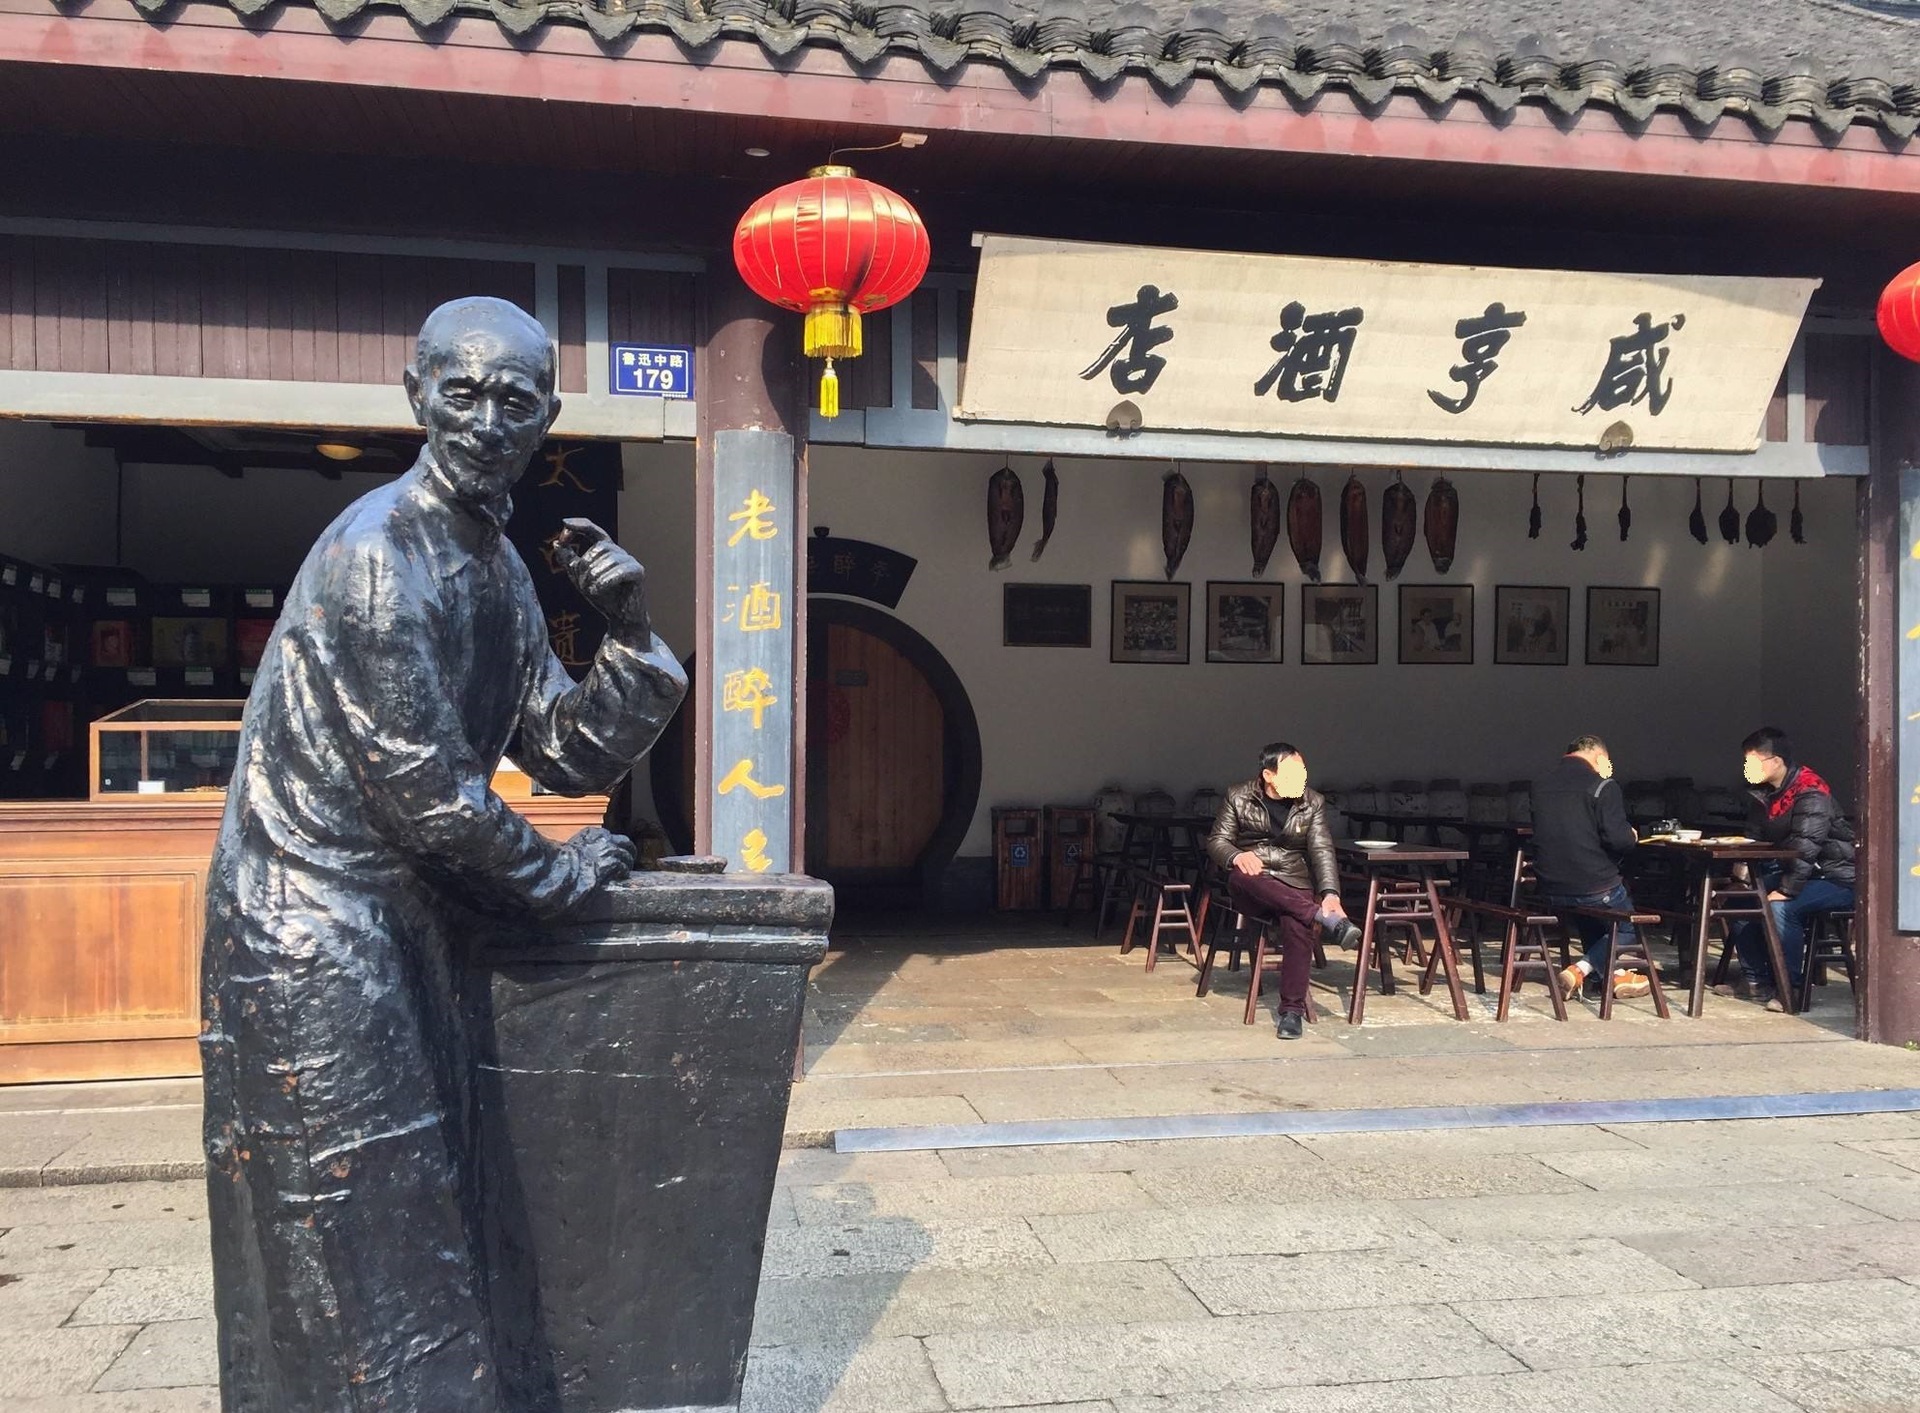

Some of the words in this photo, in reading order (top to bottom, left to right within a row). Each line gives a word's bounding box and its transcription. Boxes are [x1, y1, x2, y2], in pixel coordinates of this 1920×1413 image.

[622, 352, 684, 368] 鲁迅中路
[633, 368, 674, 390] 179
[1078, 284, 1686, 416] 咸亨酒店
[718, 488, 785, 873] 老酒醉人多
